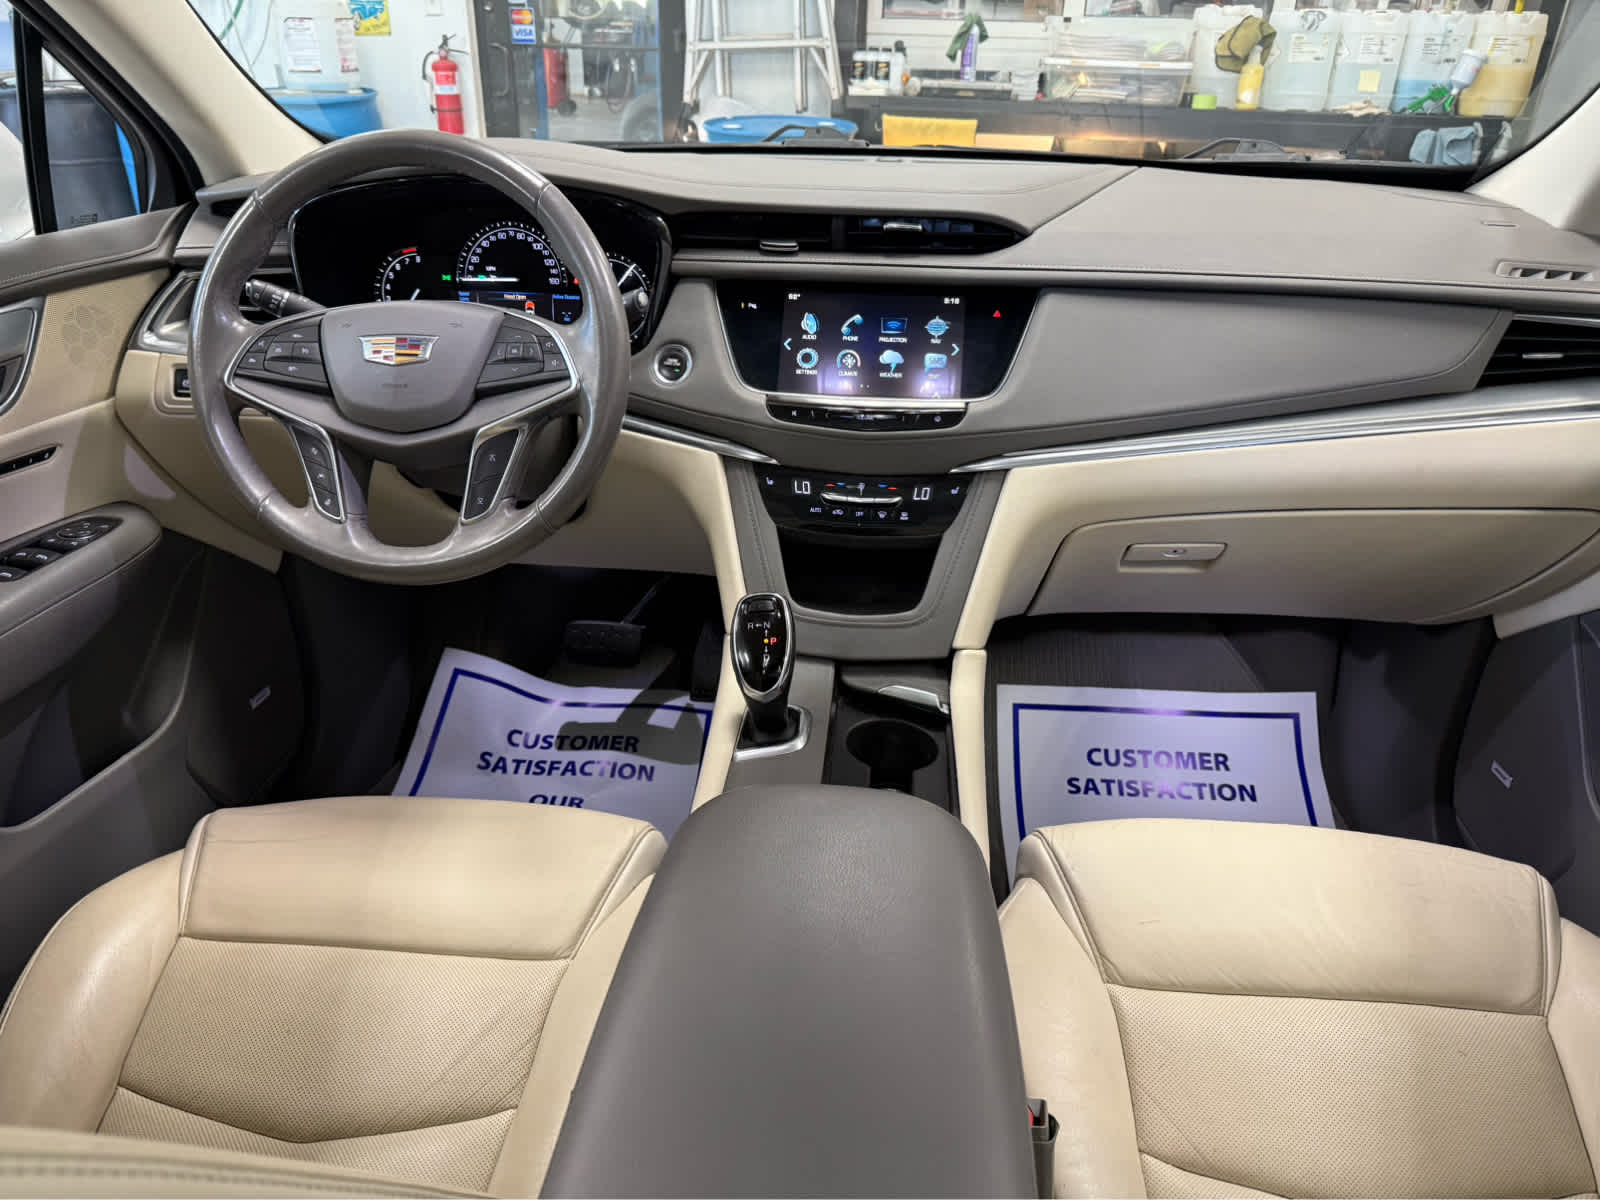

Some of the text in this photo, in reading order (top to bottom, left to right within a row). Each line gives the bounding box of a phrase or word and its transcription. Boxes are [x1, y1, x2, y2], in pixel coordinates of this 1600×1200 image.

[514, 28, 534, 37] VISA
[794, 479, 811, 495] LO
[912, 487, 931, 501] LO
[770, 637, 777, 645] P
[506, 728, 640, 753] CUSTOMER
[476, 751, 656, 782] SATISFACTION
[1086, 747, 1231, 772] CUSTOMER
[1066, 776, 1258, 803] SATISFACTION
